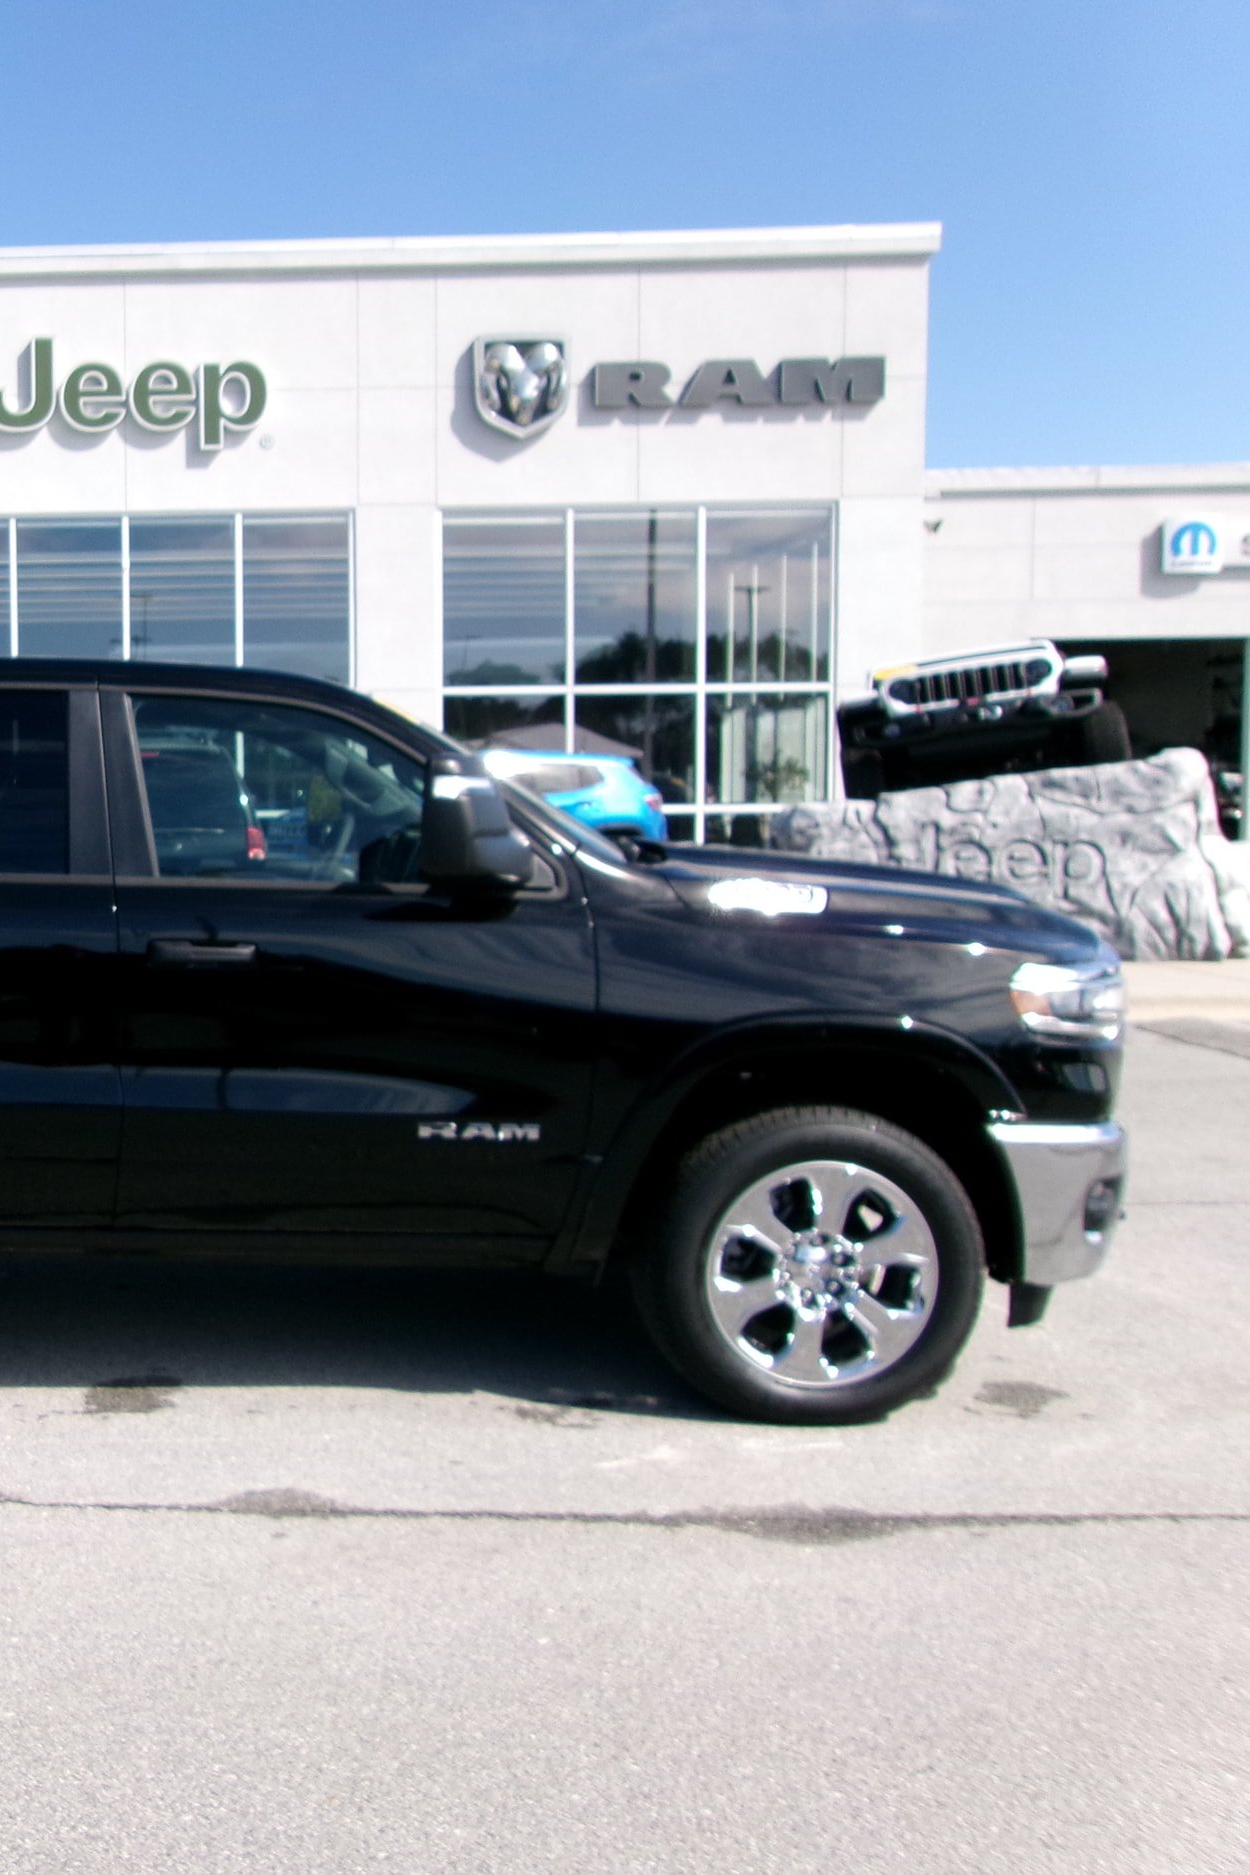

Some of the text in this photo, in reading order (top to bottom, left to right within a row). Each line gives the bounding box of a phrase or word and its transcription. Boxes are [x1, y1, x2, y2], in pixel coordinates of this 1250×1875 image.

[593, 356, 886, 408] RAM
[892, 820, 1106, 902] Jeep
[417, 1121, 541, 1141] RAM
